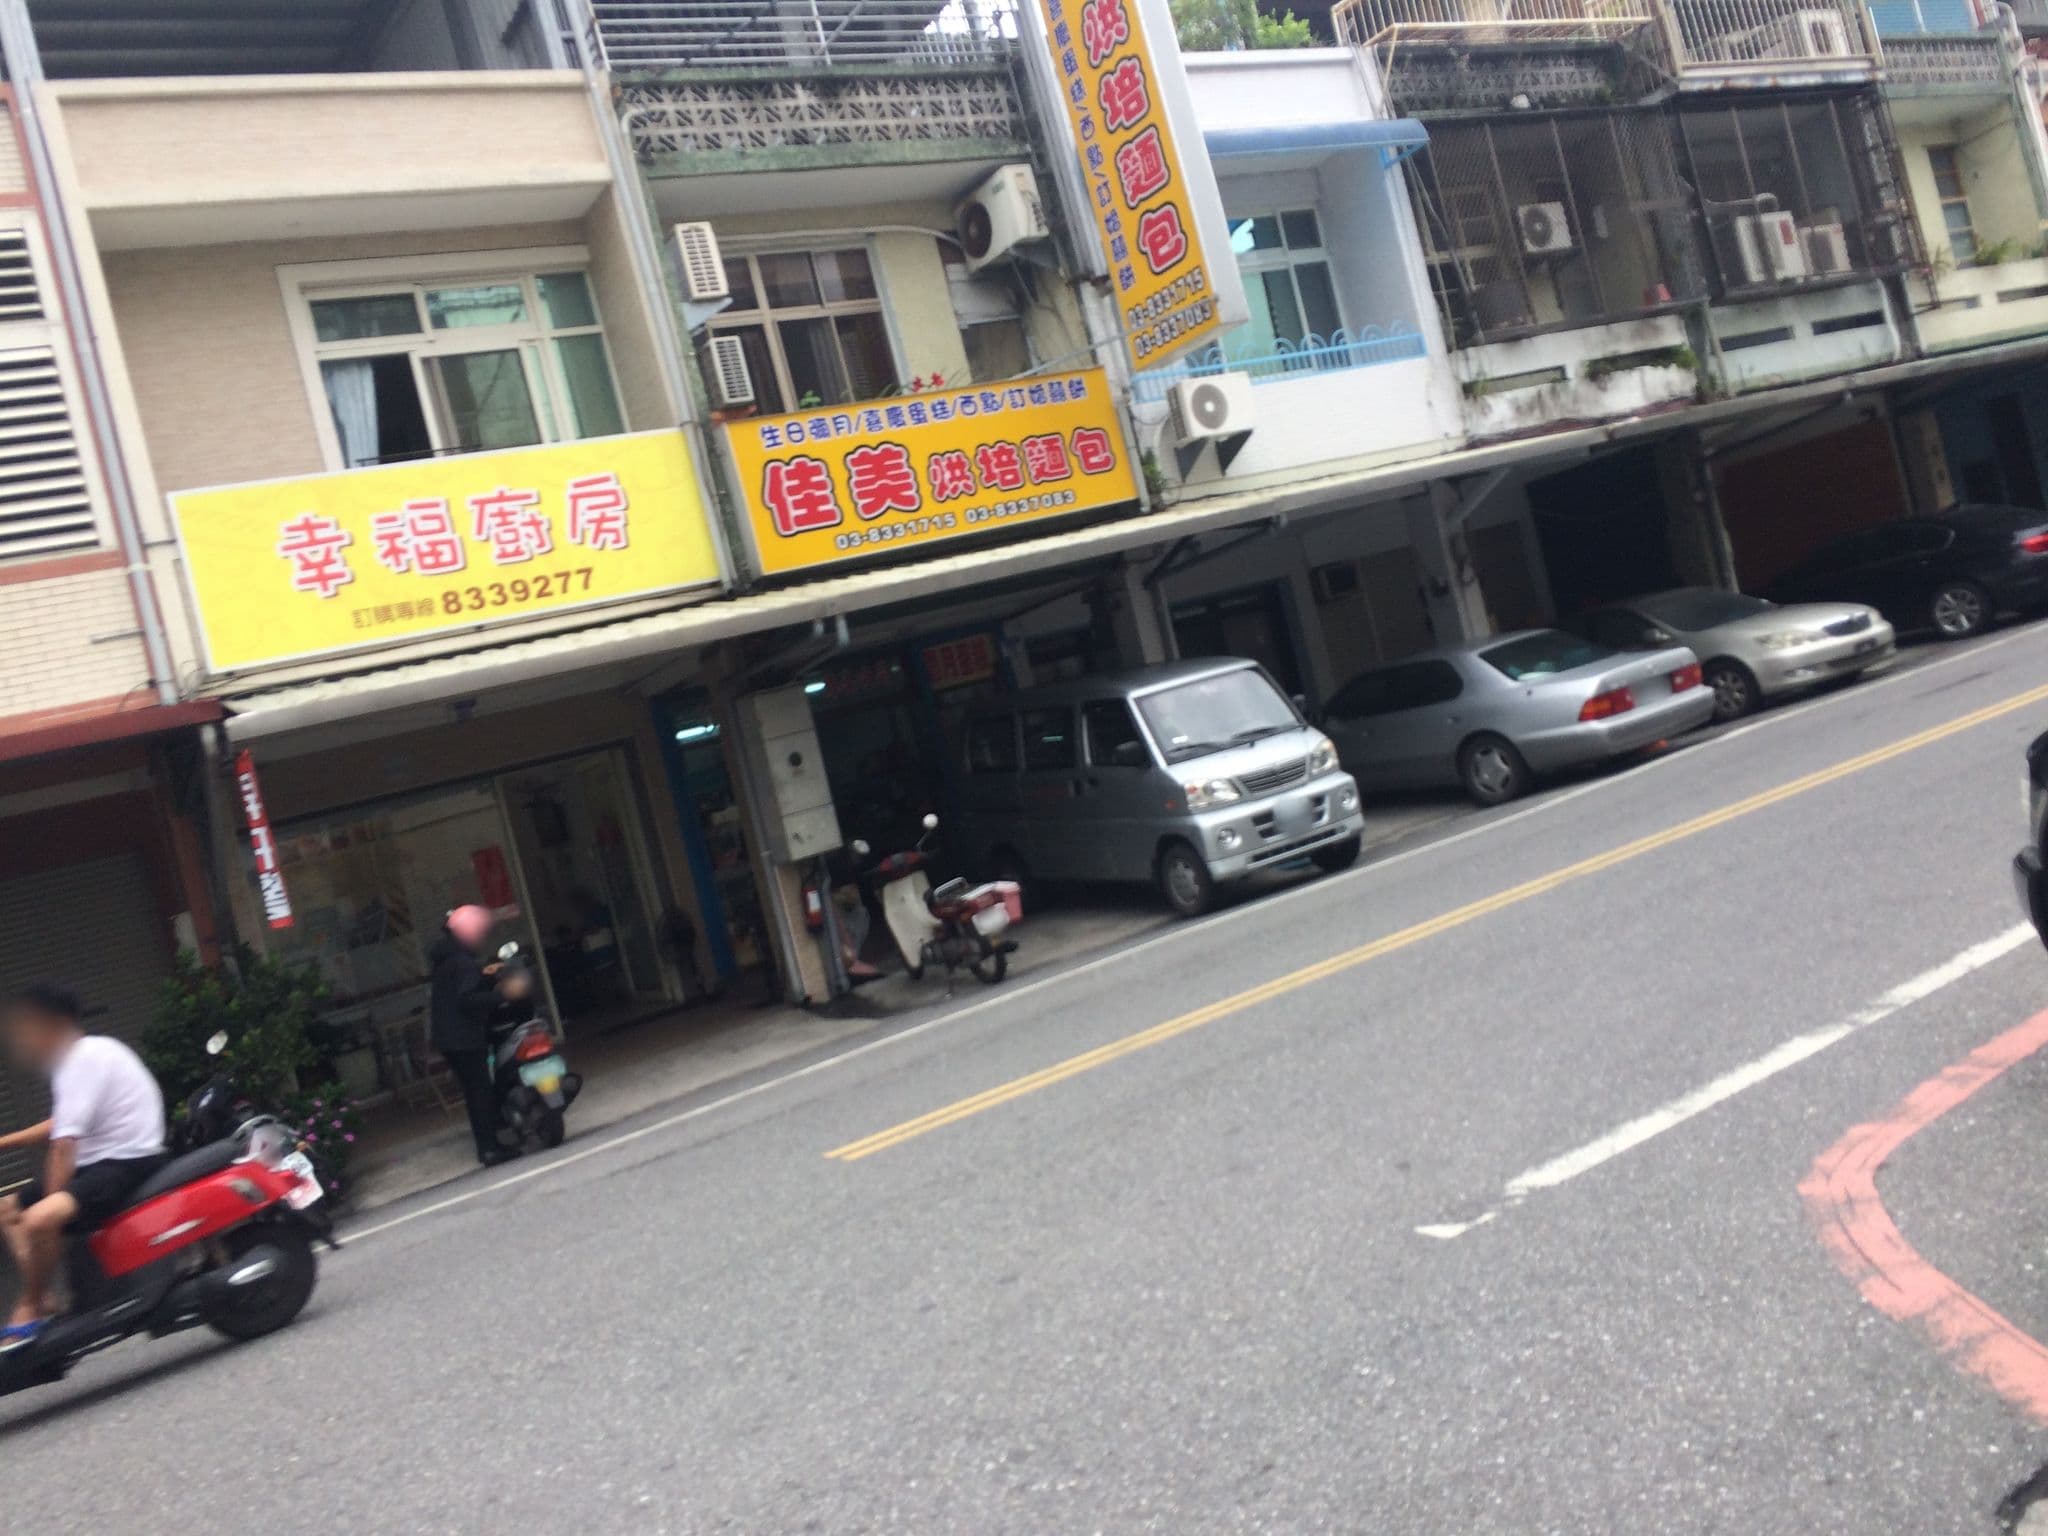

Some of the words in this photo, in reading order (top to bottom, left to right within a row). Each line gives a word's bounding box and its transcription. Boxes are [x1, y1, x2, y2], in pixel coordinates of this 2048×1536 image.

[279, 474, 629, 598] 幸福廚房
[834, 513, 956, 550] 03-8331715
[964, 490, 1075, 524] 03-8337083
[442, 567, 594, 615] 8339277
